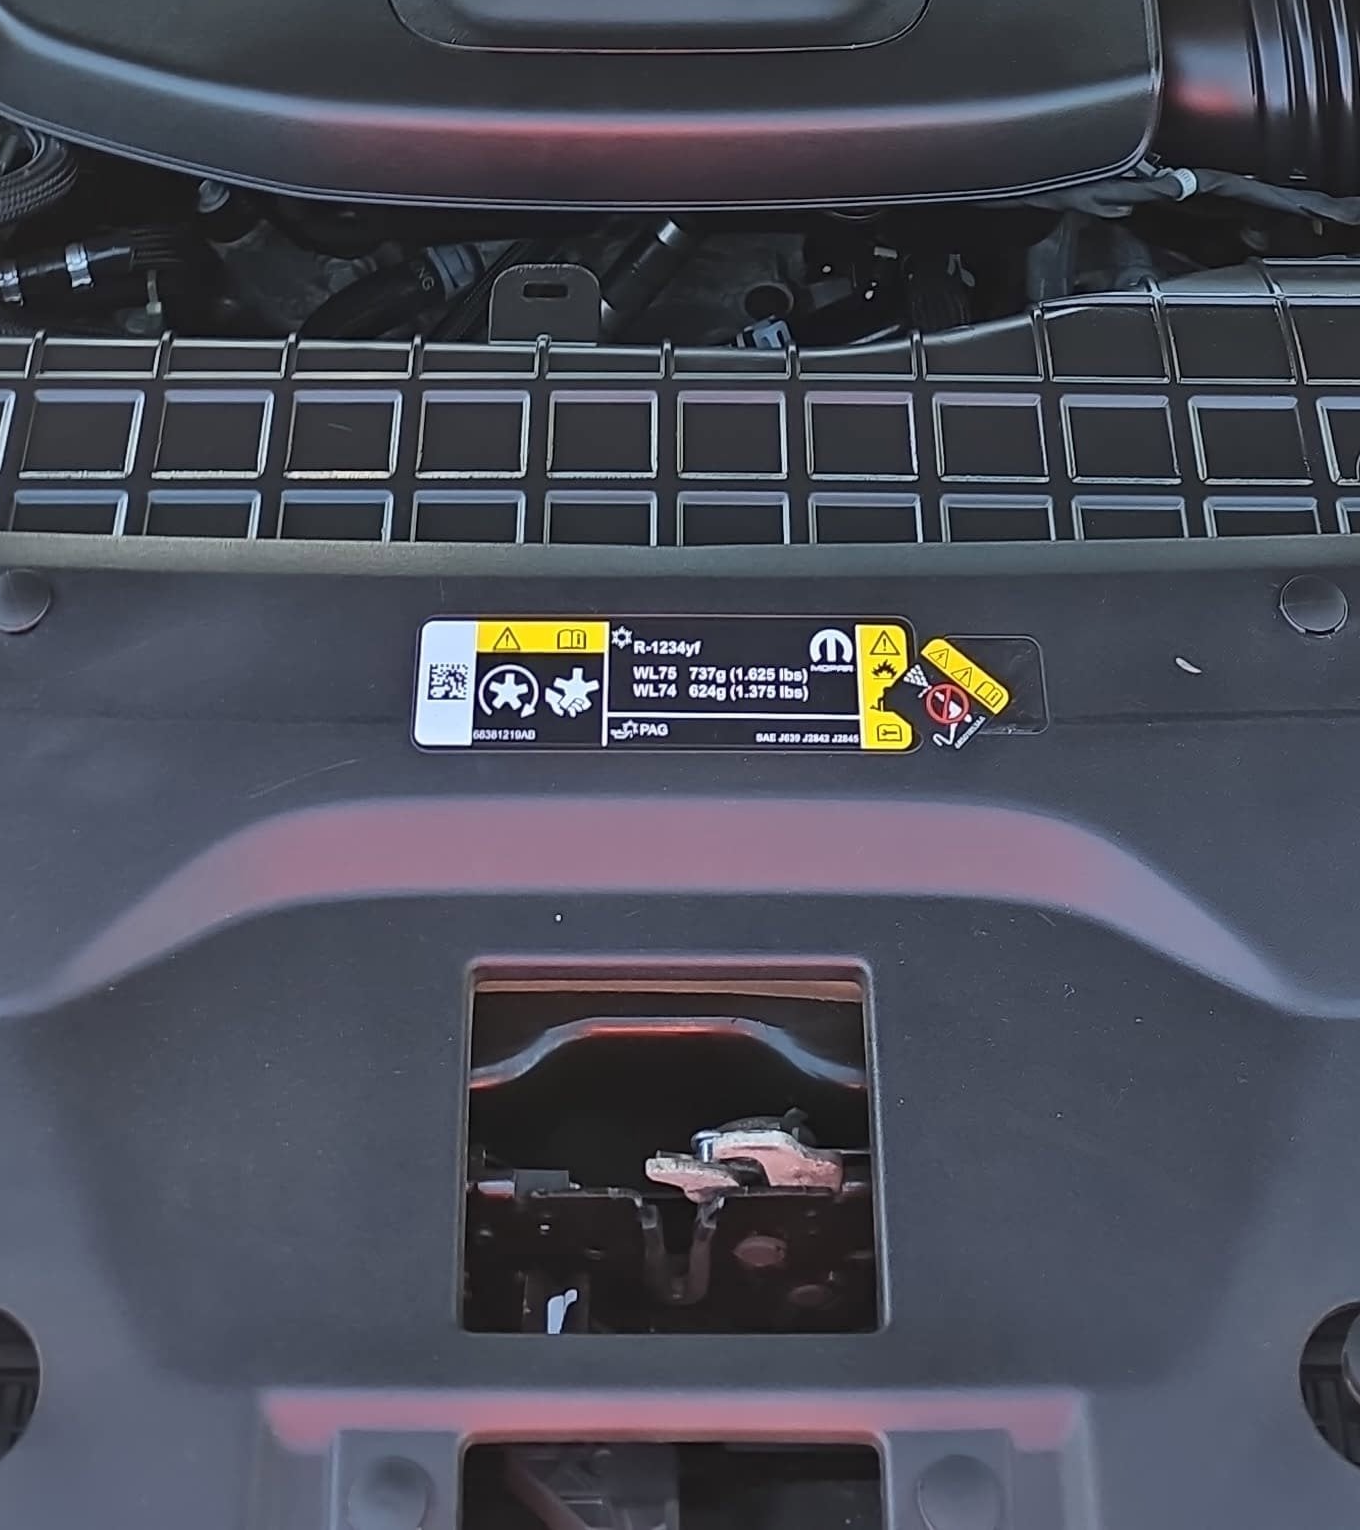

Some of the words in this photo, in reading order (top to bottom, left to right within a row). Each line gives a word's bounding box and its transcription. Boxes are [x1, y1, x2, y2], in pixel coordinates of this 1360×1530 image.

[633, 640, 702, 657] R-1234yf
[633, 666, 677, 680] WL75
[689, 667, 727, 683] 737g
[729, 667, 776, 684] (1.625
[779, 668, 808, 684] lbs)
[633, 683, 677, 698] WL74
[689, 684, 727, 701] 624g
[729, 684, 776, 701] (1.375
[779, 685, 809, 702] lbs)
[639, 723, 668, 736] PAG
[755, 733, 777, 743] SAE
[778, 733, 801, 743] J639
